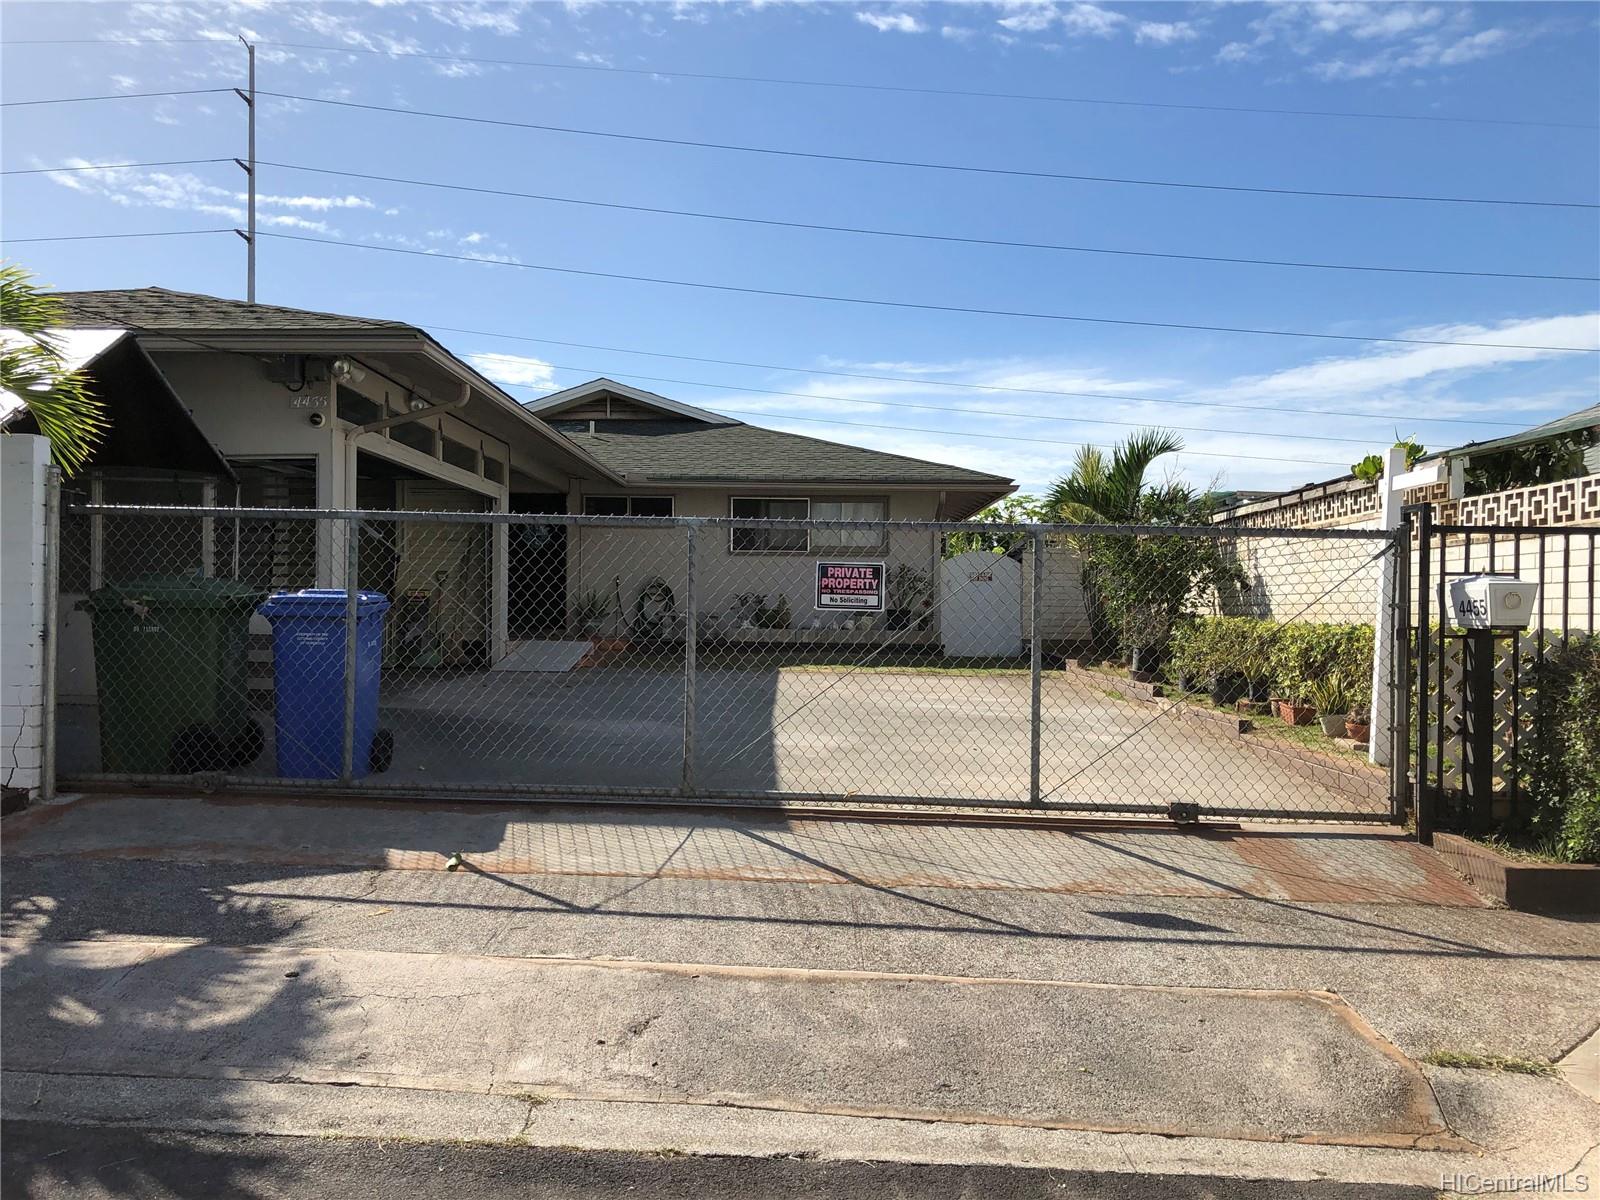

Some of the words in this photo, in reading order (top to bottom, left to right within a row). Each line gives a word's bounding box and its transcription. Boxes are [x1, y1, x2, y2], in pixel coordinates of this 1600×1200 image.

[827, 567, 873, 578] PRIVATE
[821, 578, 878, 589] PROPERTY
[840, 596, 868, 605] Soliciting
[1459, 600, 1487, 616] 4455
